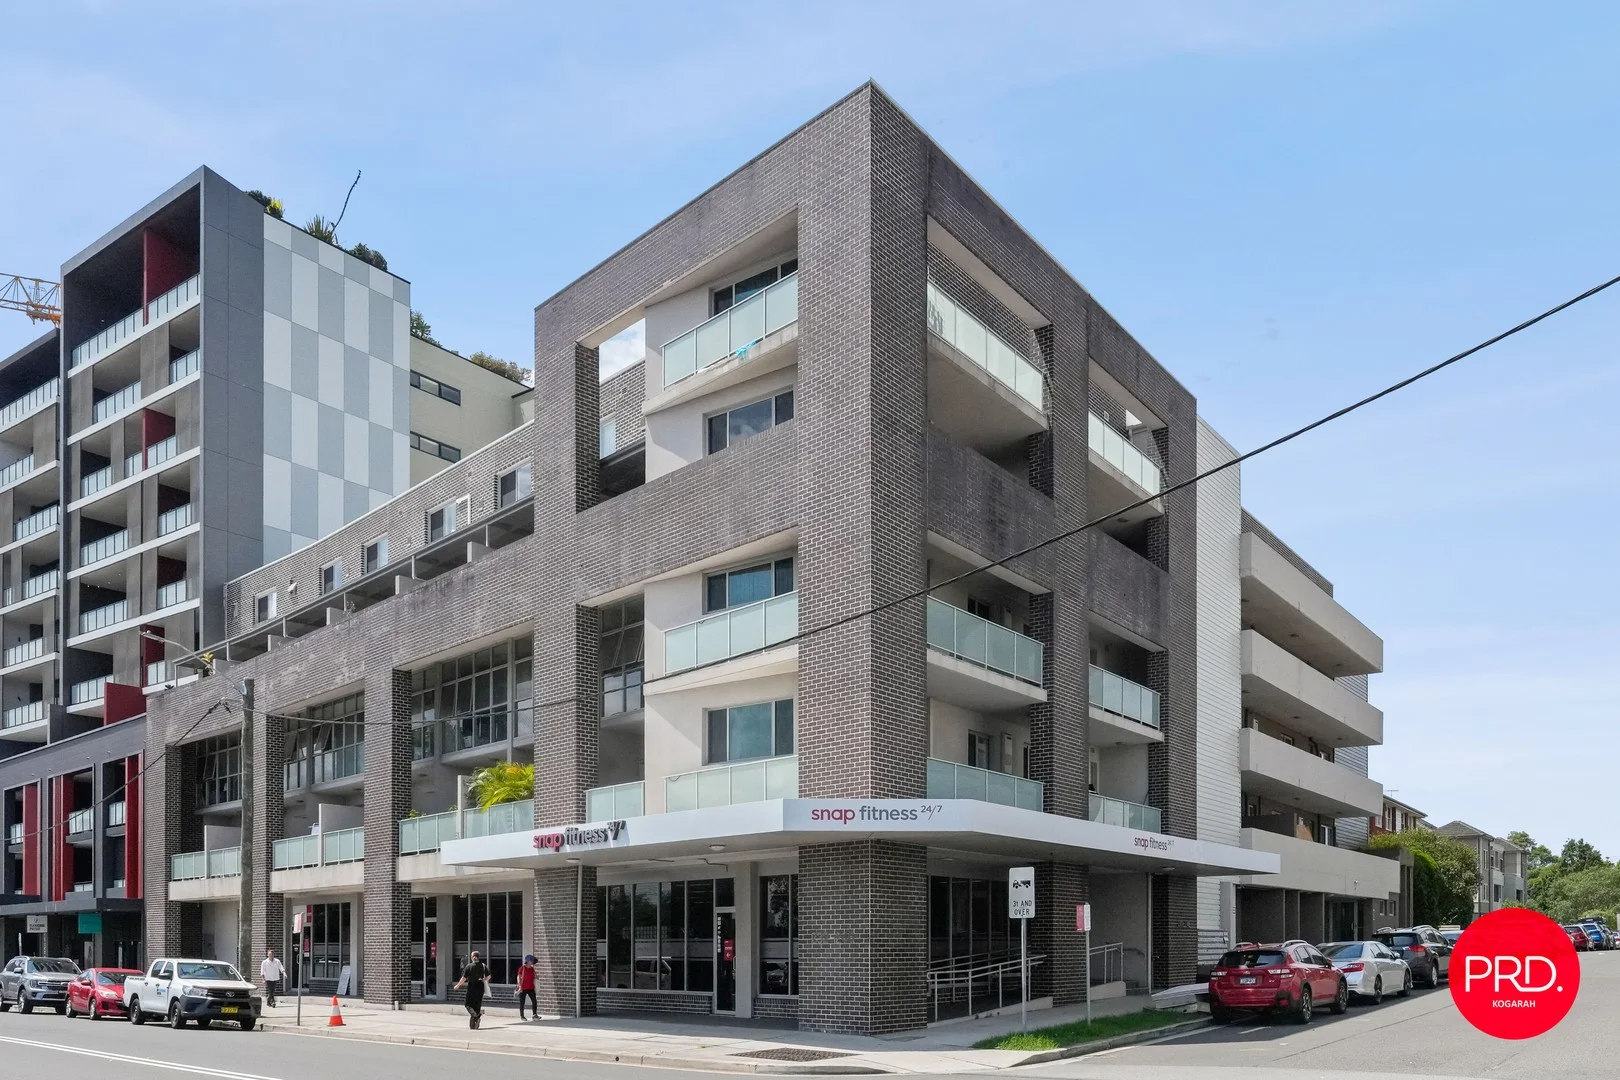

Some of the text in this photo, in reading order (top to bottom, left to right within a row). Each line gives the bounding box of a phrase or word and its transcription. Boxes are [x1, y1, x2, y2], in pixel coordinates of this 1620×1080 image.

[811, 805, 943, 825] snap fitness 24/7
[533, 833, 563, 852] snap
[564, 827, 608, 846] fitness
[1134, 837, 1149, 851] snap
[1149, 836, 1168, 851] fitness
[1013, 908, 1030, 916] OVER
